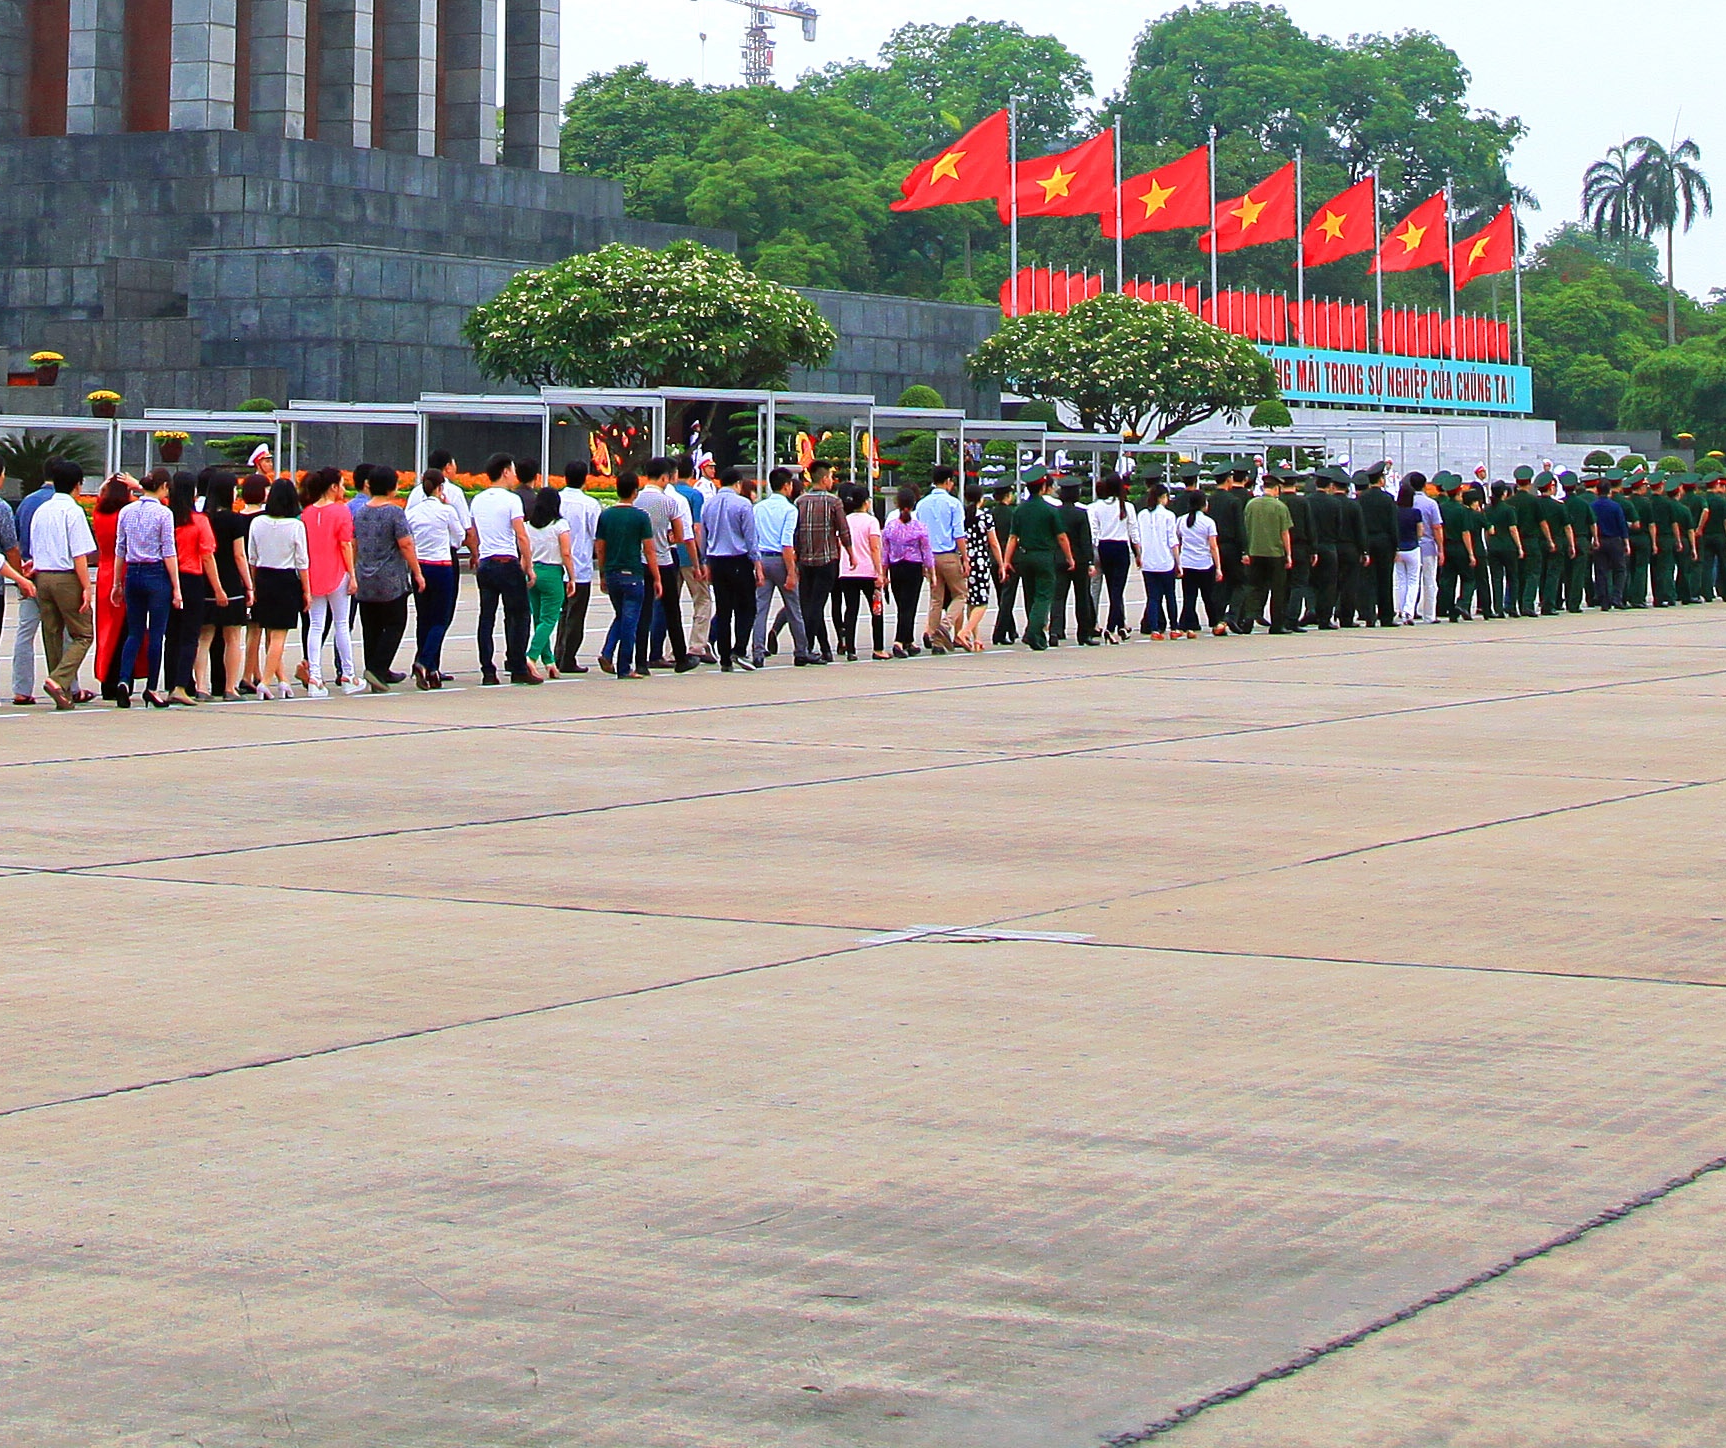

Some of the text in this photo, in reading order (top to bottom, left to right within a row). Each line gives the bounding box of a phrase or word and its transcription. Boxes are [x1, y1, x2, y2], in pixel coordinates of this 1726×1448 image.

[1324, 361, 1363, 395] TRONG
[1368, 362, 1384, 403] SỰ
[1387, 362, 1428, 405] NGHIỆP
[1431, 361, 1453, 401] CỦA
[1457, 366, 1491, 403] CHÚNG
[1494, 375, 1508, 405] TA
